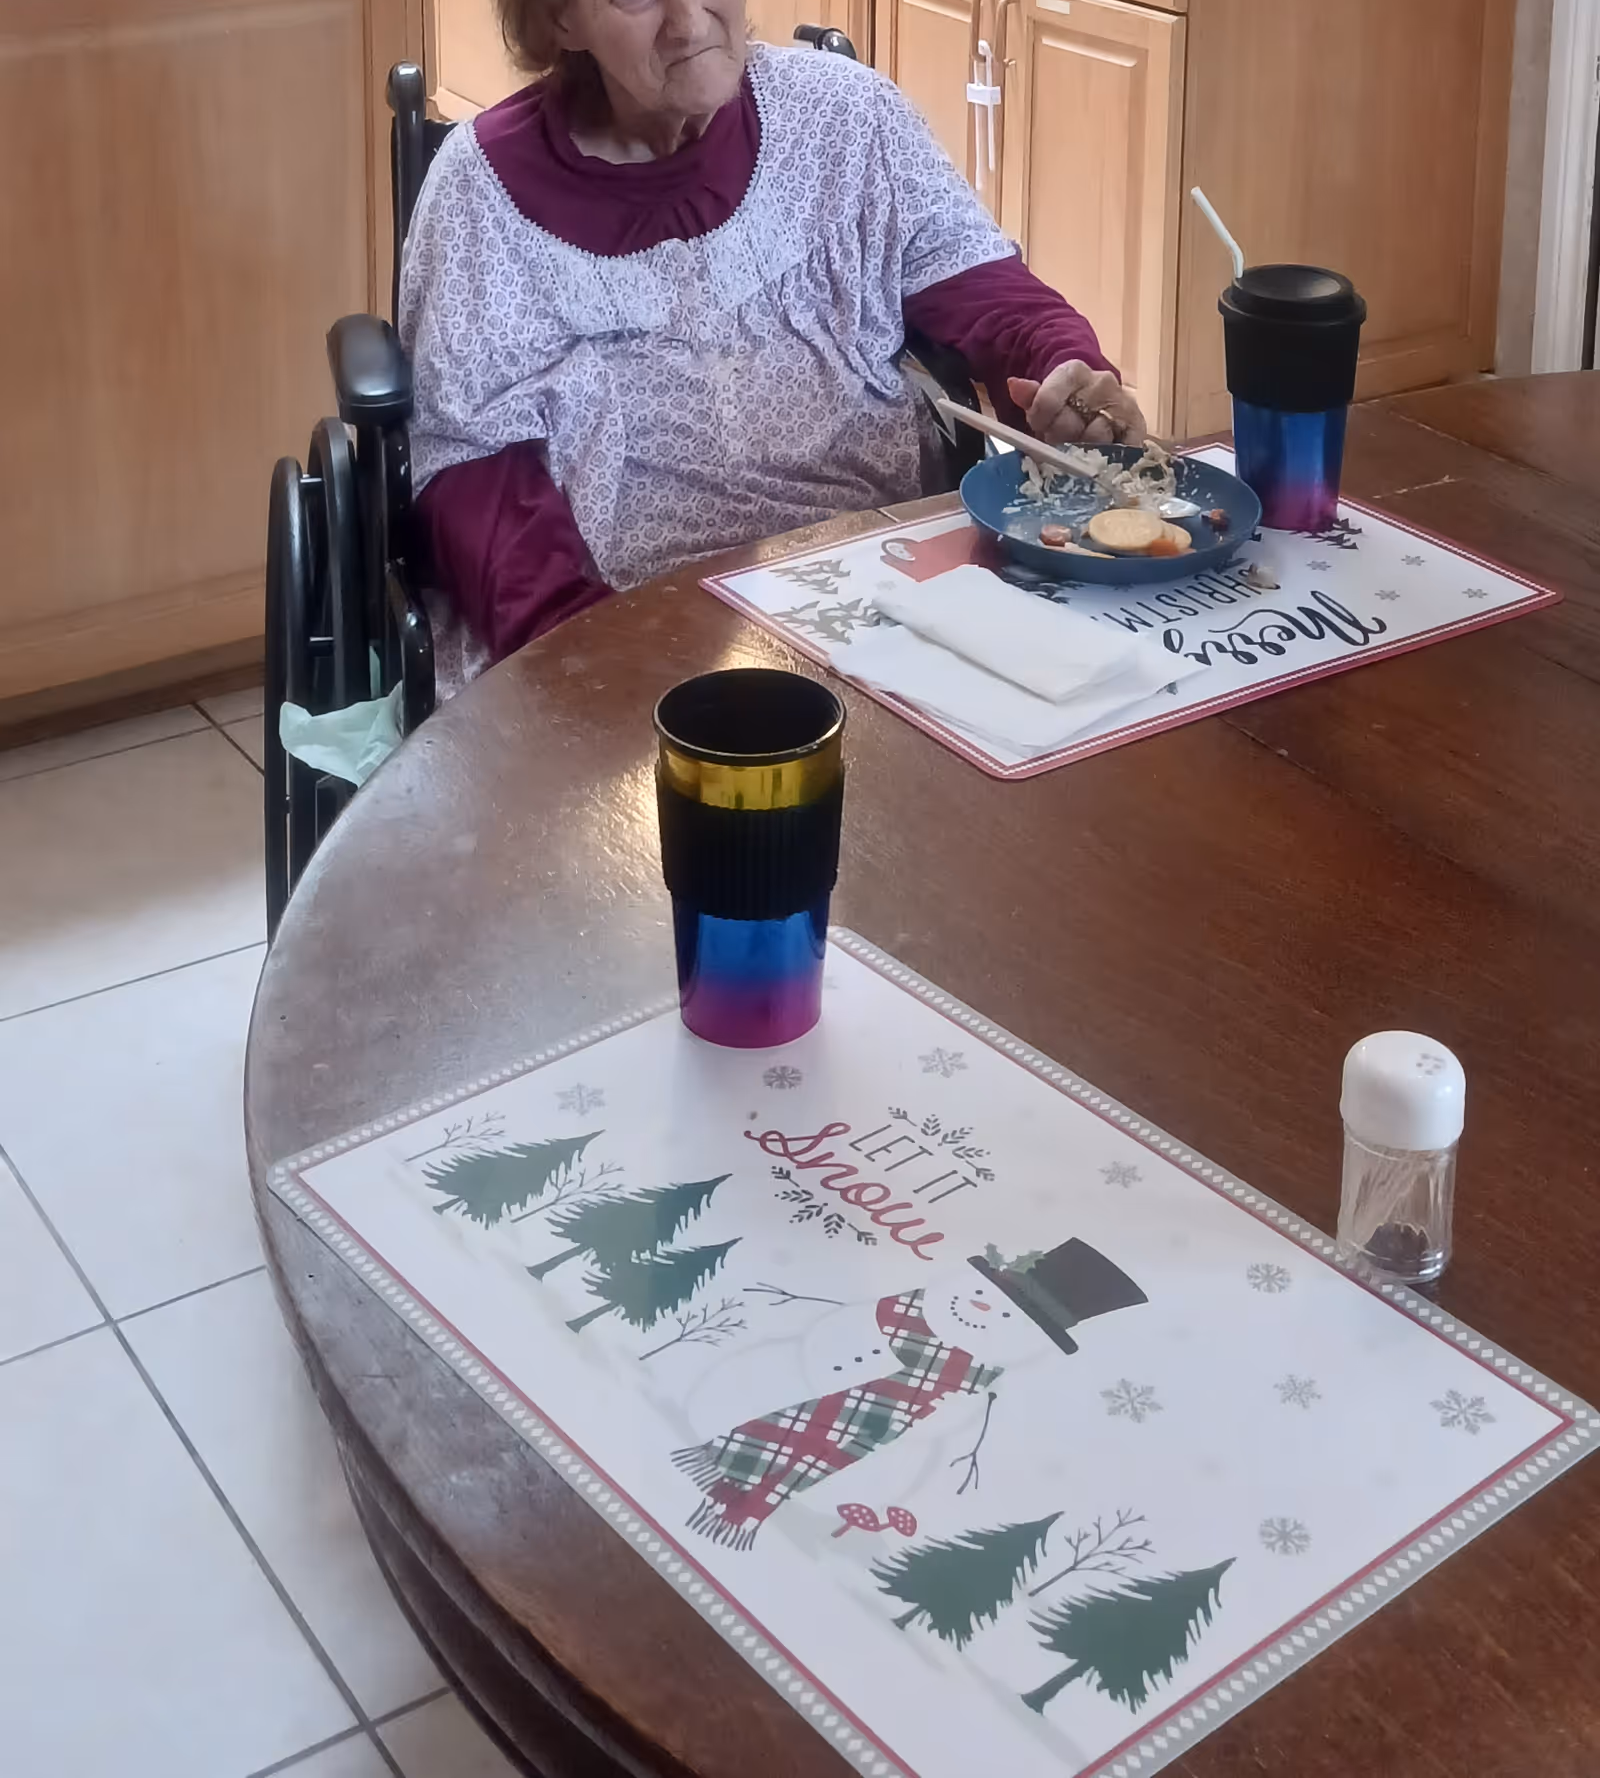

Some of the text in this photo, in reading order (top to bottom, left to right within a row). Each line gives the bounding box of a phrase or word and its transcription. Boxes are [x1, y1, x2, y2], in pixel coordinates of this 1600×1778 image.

[1163, 590, 1388, 667] Merry
[743, 1121, 945, 1261] Snow
[849, 1124, 978, 1204] LET IT
